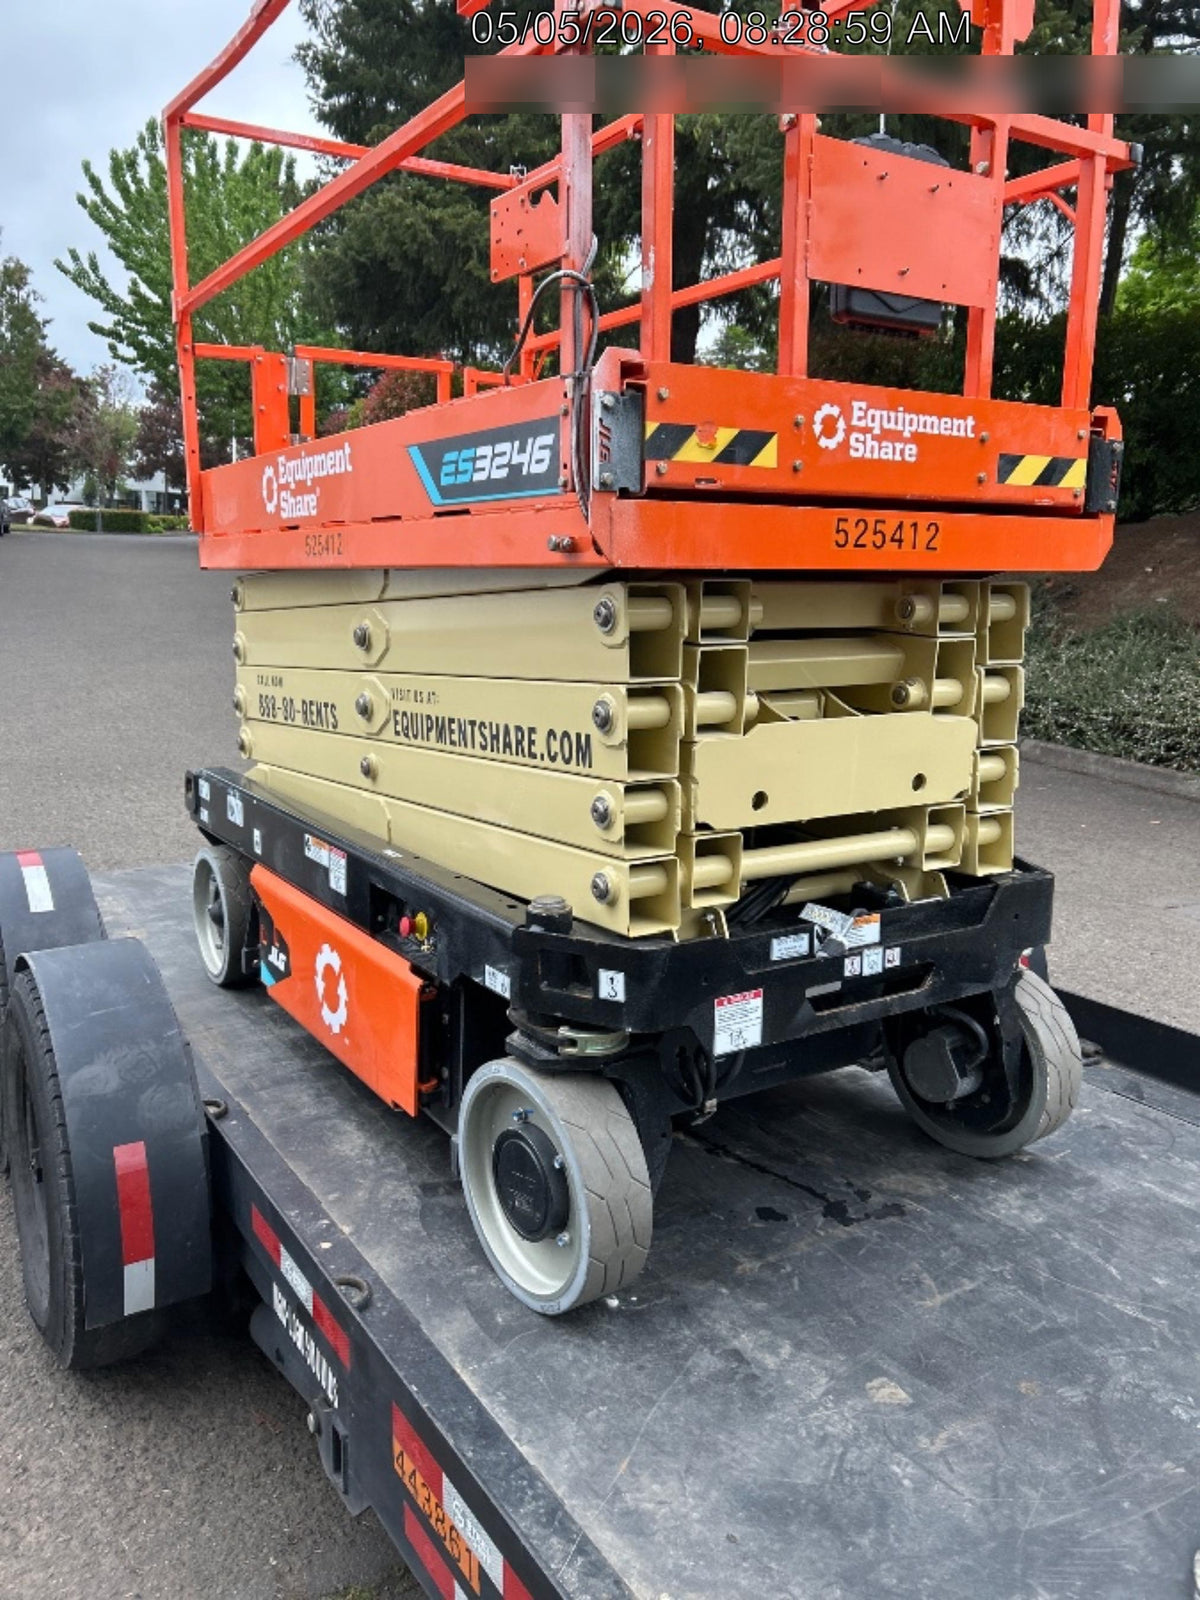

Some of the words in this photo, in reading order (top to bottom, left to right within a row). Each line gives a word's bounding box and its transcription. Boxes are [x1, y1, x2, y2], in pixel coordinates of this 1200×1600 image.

[850, 401, 975, 439] Equipment
[277, 442, 353, 488] Equipment
[440, 433, 555, 487] ES3246
[849, 432, 918, 463] Share
[279, 492, 318, 519] Share
[304, 533, 343, 557] 525412
[834, 517, 940, 551] 525412
[392, 709, 593, 769] EQUIPMENTSHARE.COM
